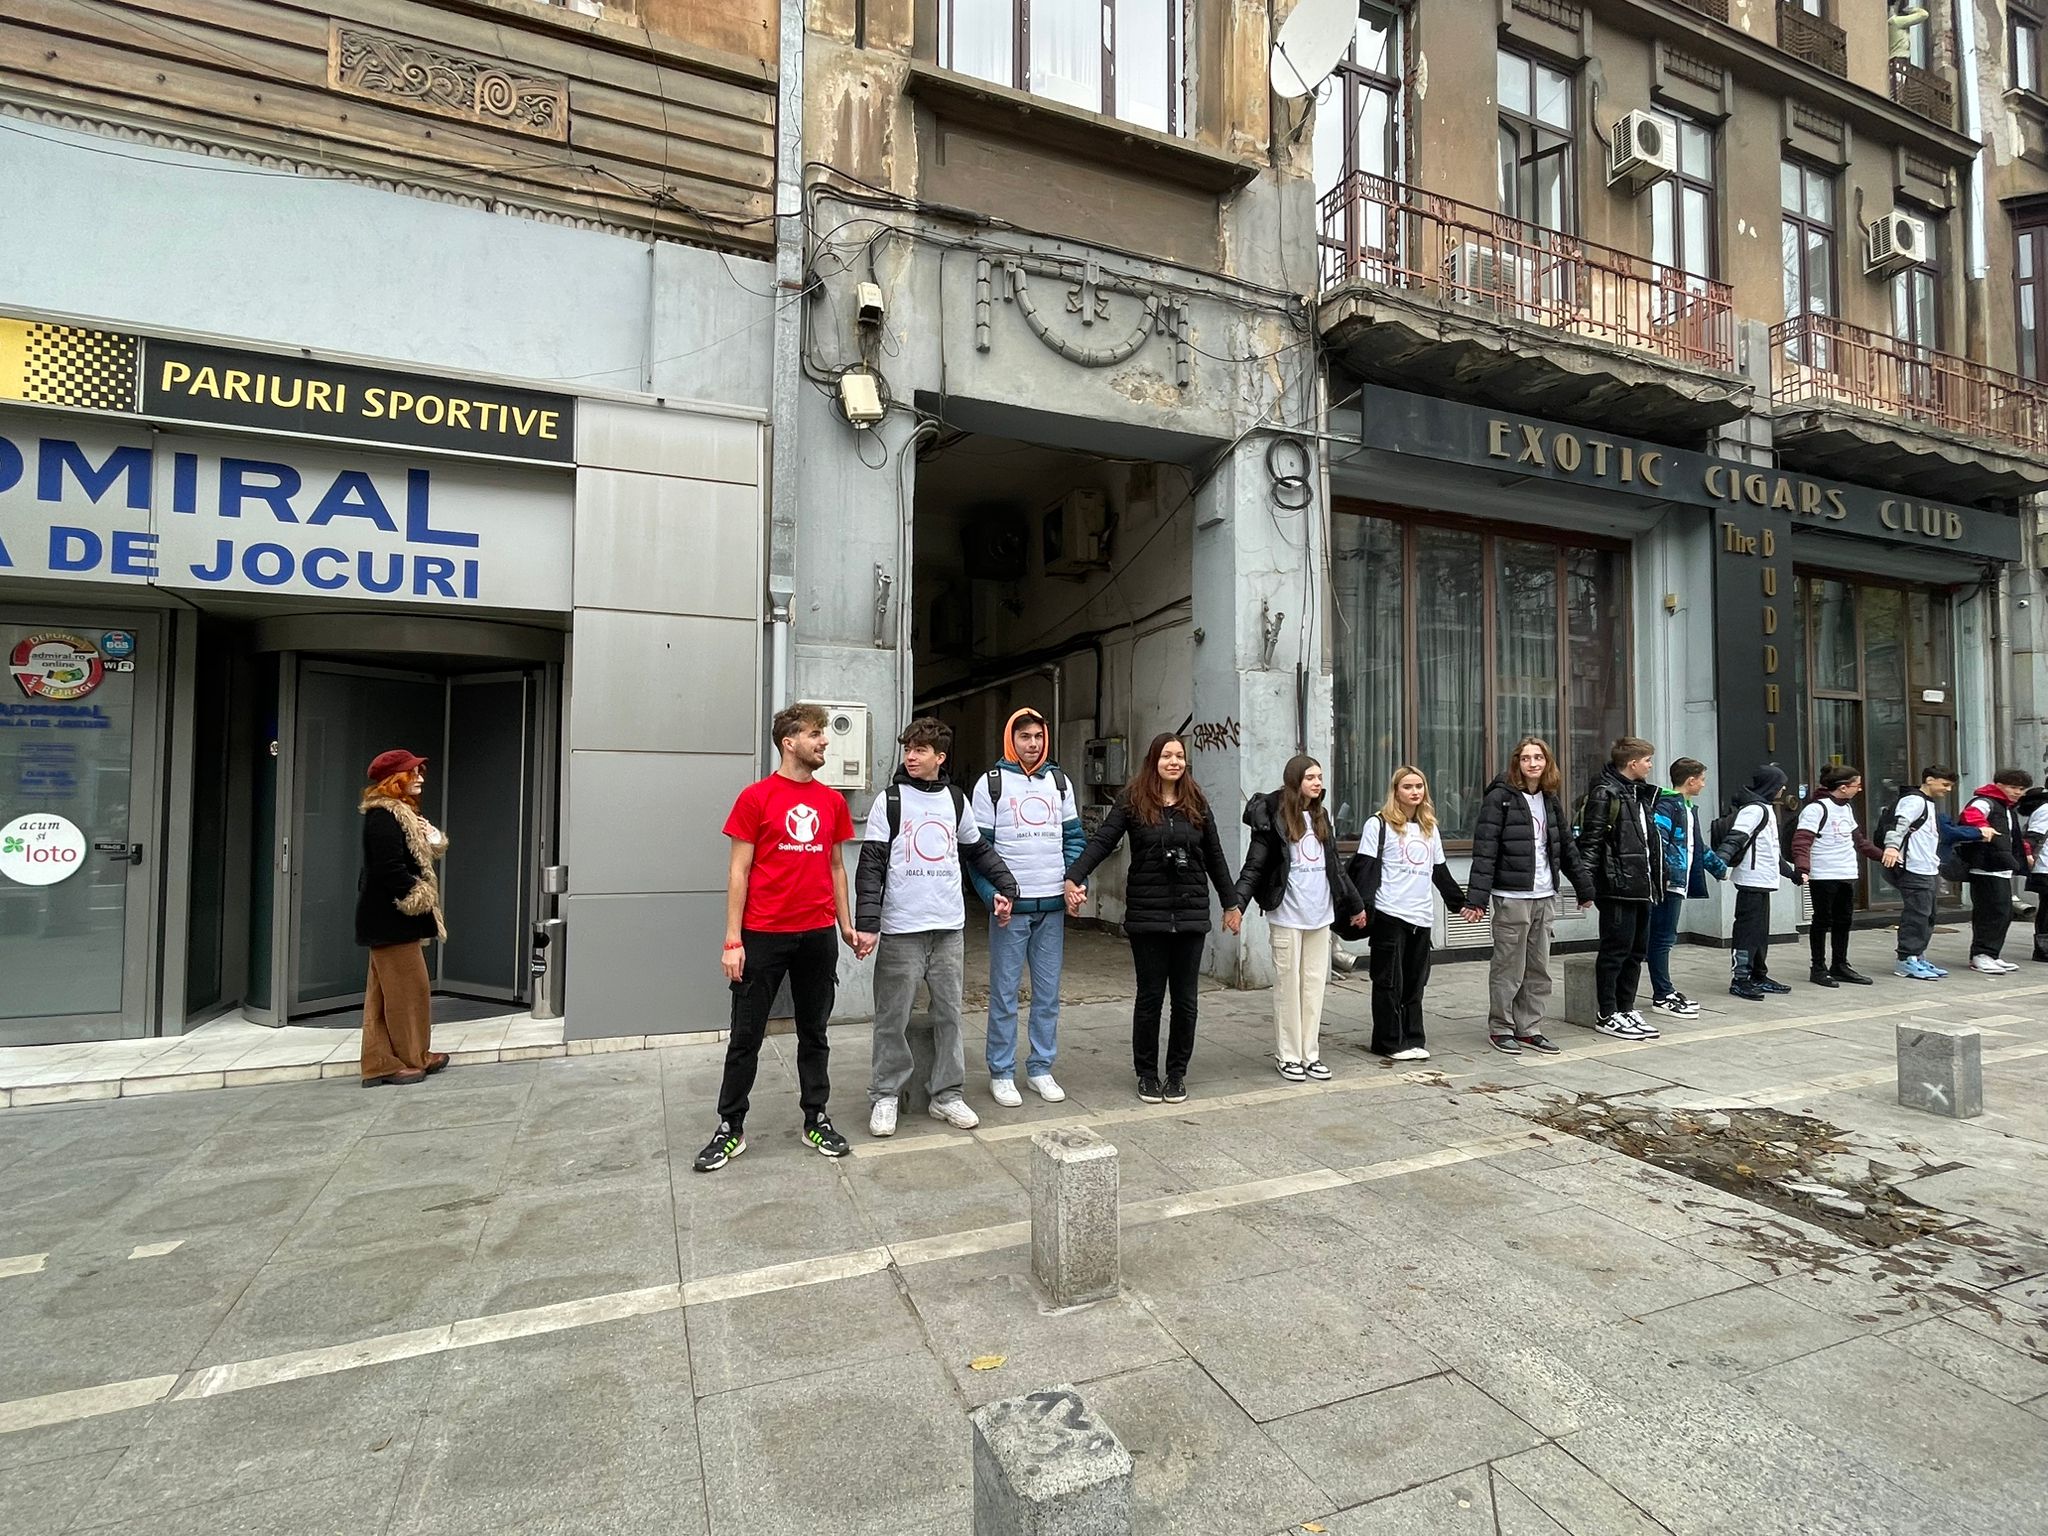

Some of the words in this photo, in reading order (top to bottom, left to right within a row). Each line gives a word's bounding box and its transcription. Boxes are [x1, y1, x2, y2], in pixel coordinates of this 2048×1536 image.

[161, 360, 346, 414] PARIURI
[361, 387, 560, 440] SPORTIVE
[1487, 420, 1664, 488] EXOTIC
[1704, 465, 1848, 521] CIGARS
[1880, 499, 1963, 541] CLUB
[1720, 522, 1757, 556] The
[48, 525, 160, 577] DE
[190, 538, 479, 599] JOCURI
[32, 653, 86, 661] admiral.ro
[42, 660, 75, 668] online
[19, 821, 61, 830] acum
[26, 844, 77, 863] loto
